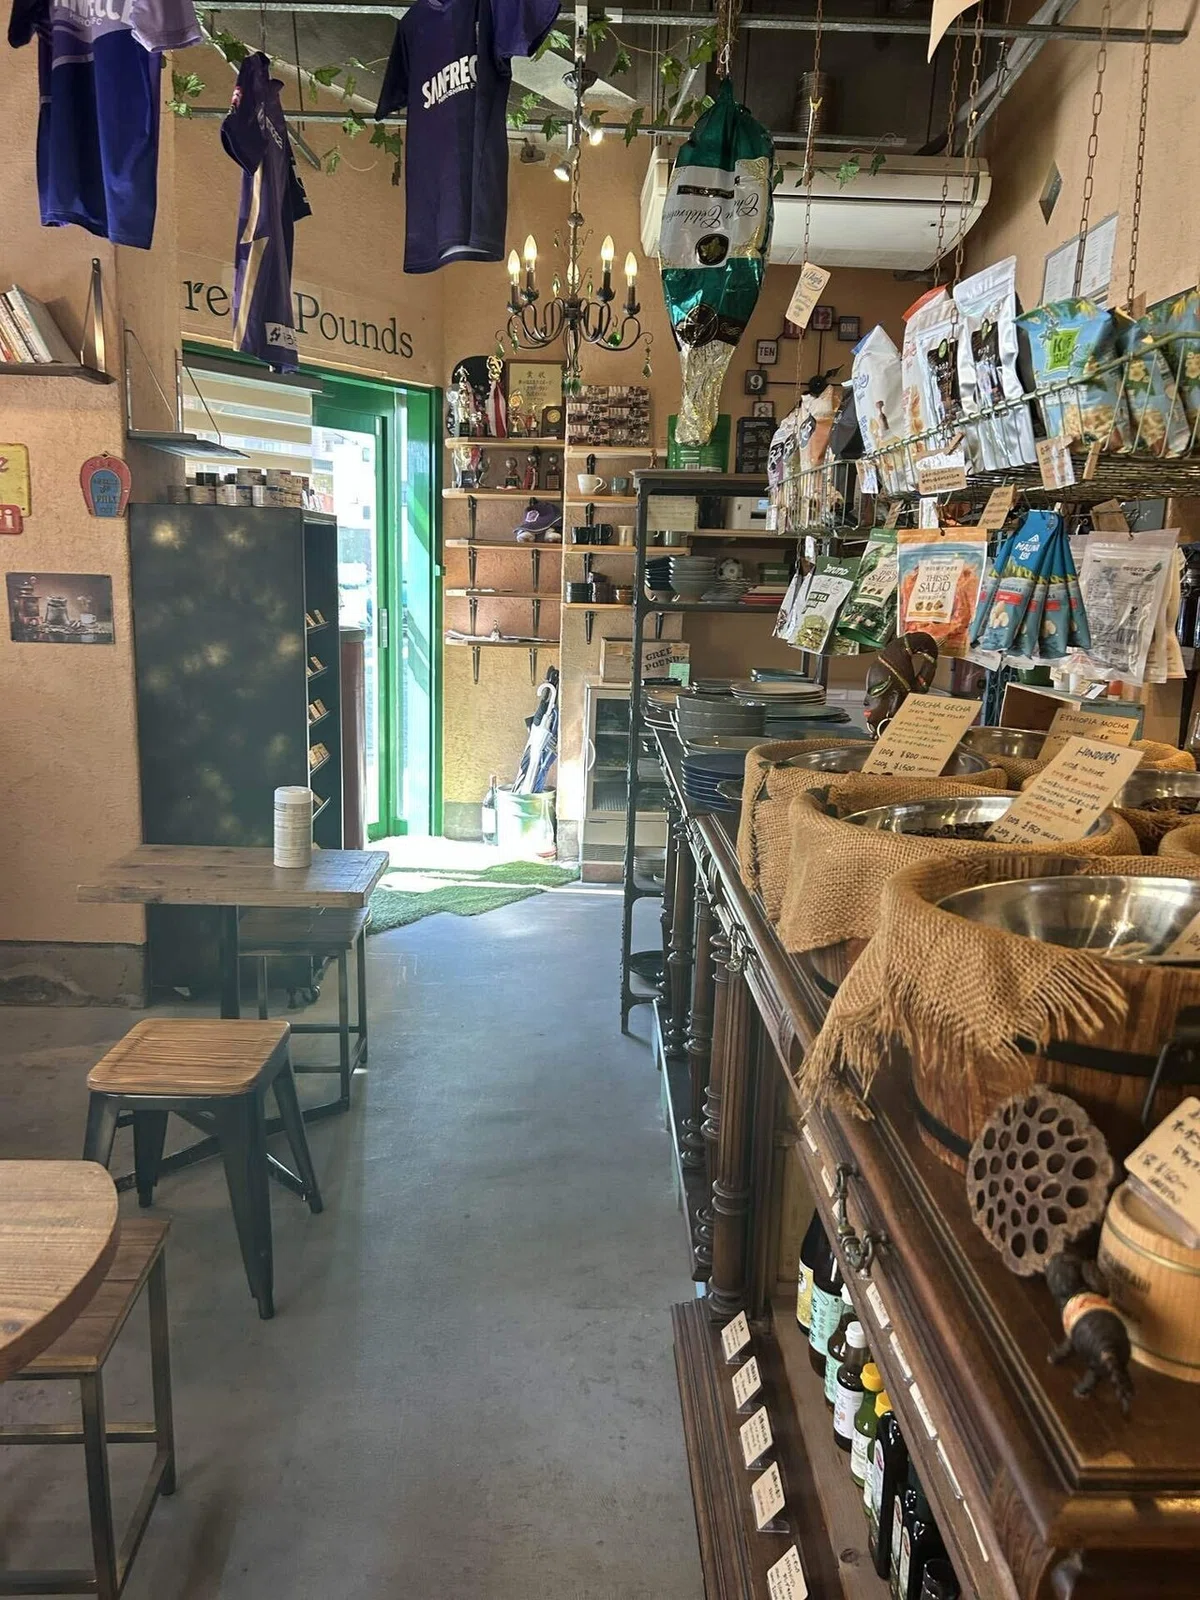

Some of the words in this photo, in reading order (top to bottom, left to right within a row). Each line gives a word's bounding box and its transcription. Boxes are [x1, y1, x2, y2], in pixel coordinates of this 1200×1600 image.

[422, 54, 478, 109] SANFREC
[293, 291, 413, 359] Pounds
[760, 347, 775, 356] TEN
[750, 375, 763, 390] 9
[823, 563, 849, 576] bruno
[645, 647, 672, 661] GREE
[910, 699, 941, 709] MOCHA
[1059, 713, 1098, 725] ETHIOPIA
[1100, 720, 1130, 730] MOCHA
[1074, 746, 1121, 765] HONDURAS
